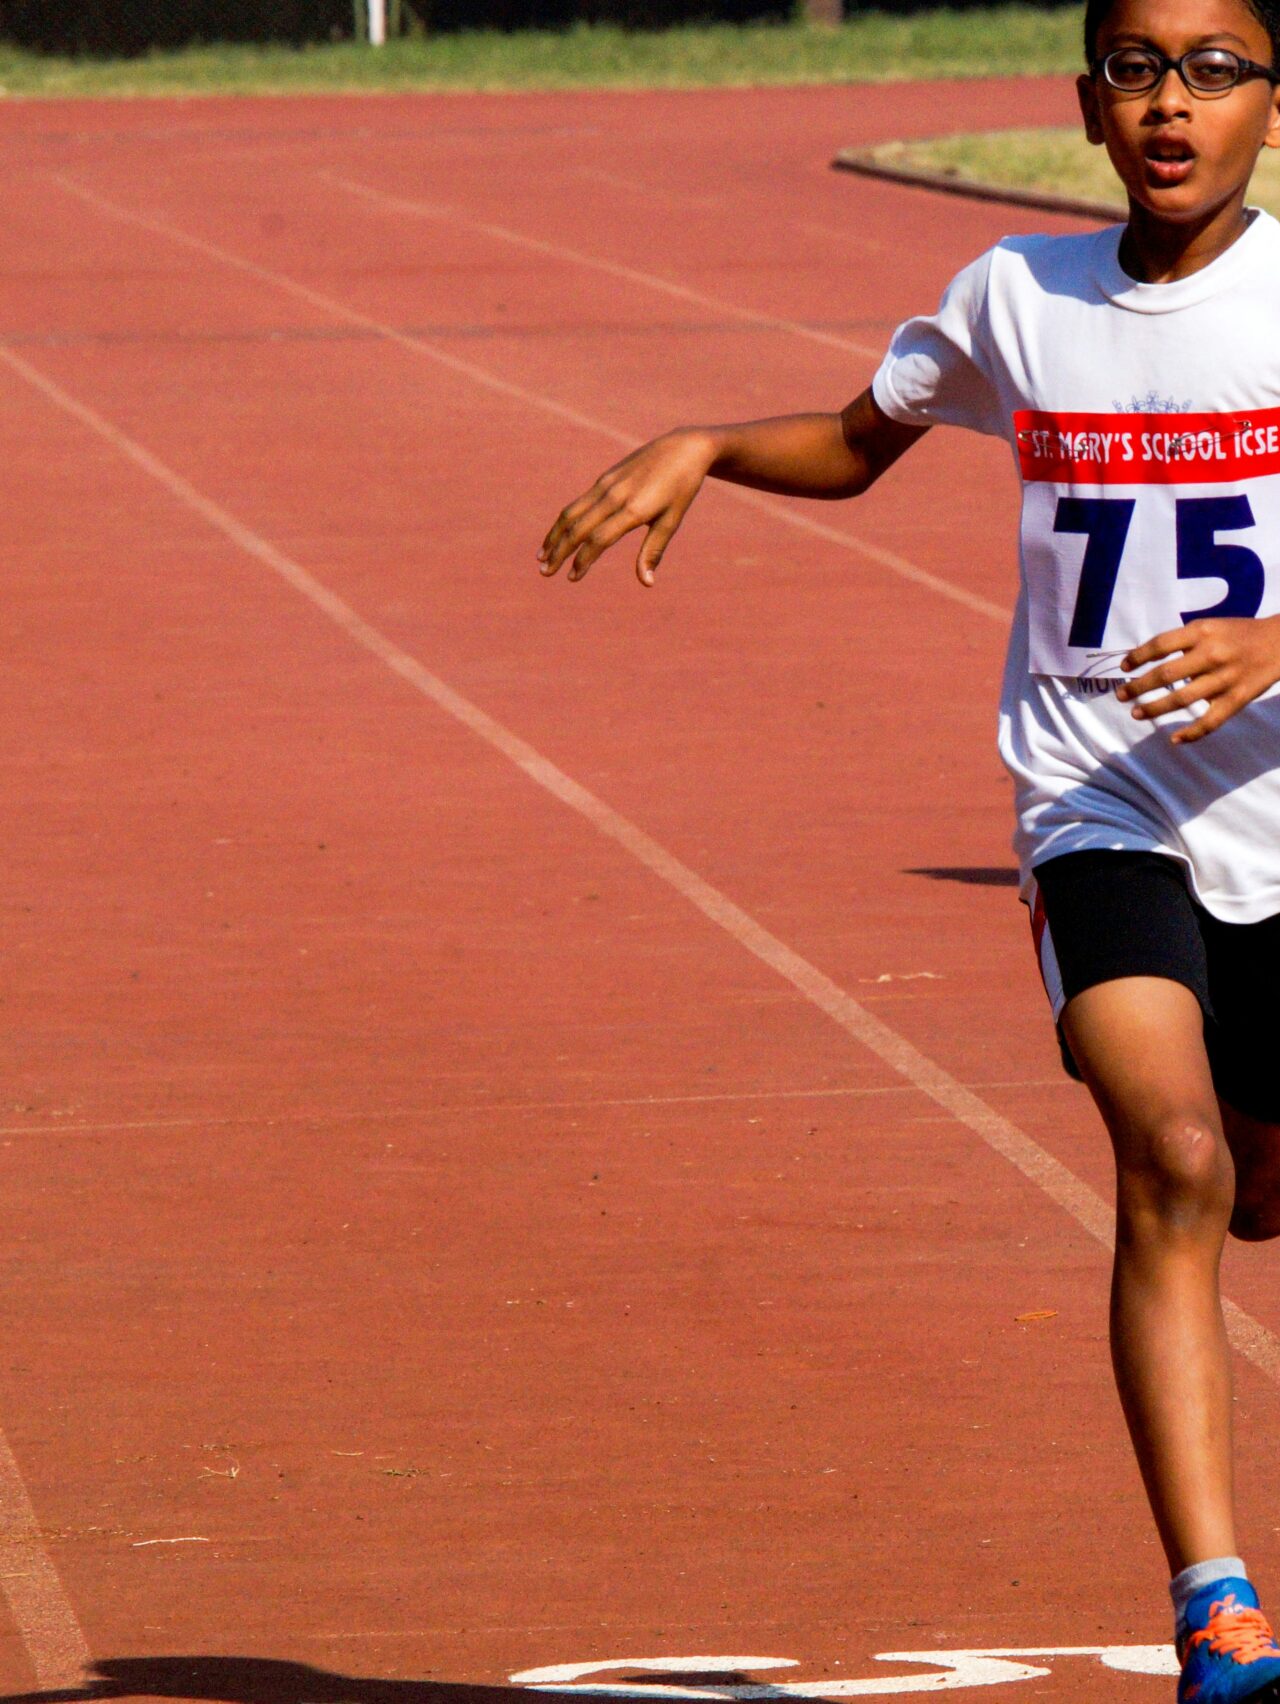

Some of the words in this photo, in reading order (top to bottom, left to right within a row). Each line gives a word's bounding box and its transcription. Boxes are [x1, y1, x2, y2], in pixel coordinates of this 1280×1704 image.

[1032, 430, 1054, 459] ST.
[1059, 431, 1134, 464] MARY'S
[1141, 431, 1227, 464] SCHOOL
[1234, 425, 1280, 459] ICSE
[1053, 494, 1266, 650] 75
